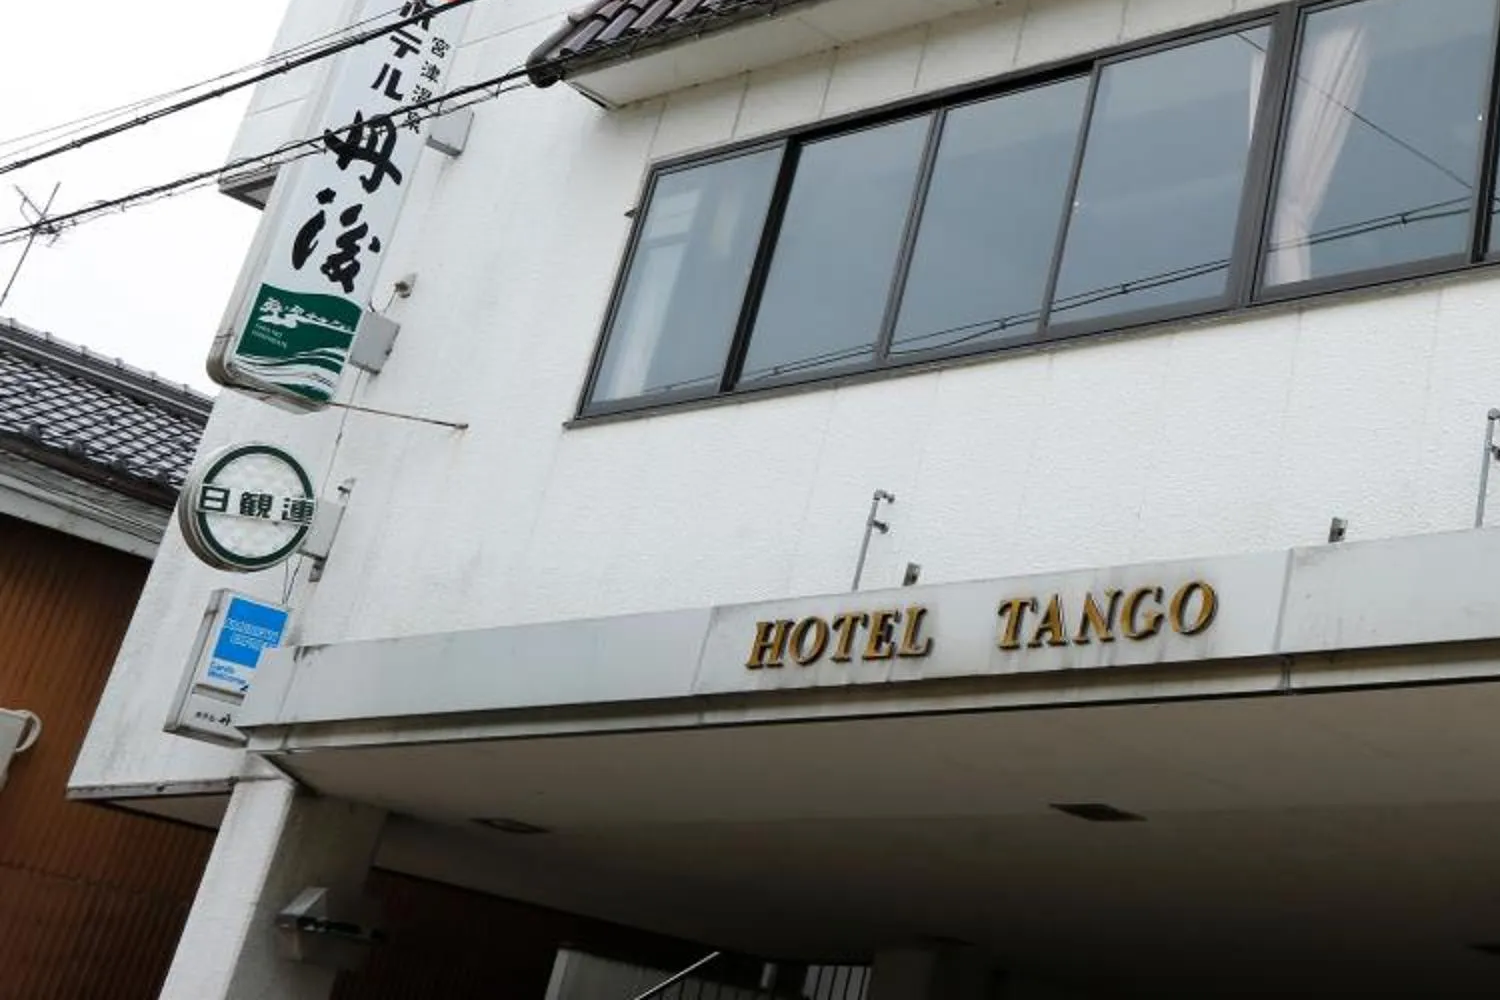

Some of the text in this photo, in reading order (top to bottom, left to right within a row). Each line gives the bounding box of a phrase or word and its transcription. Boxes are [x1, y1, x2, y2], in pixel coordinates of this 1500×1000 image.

[201, 484, 314, 525] 日観連
[745, 580, 1220, 669] HOTEL TANGO
